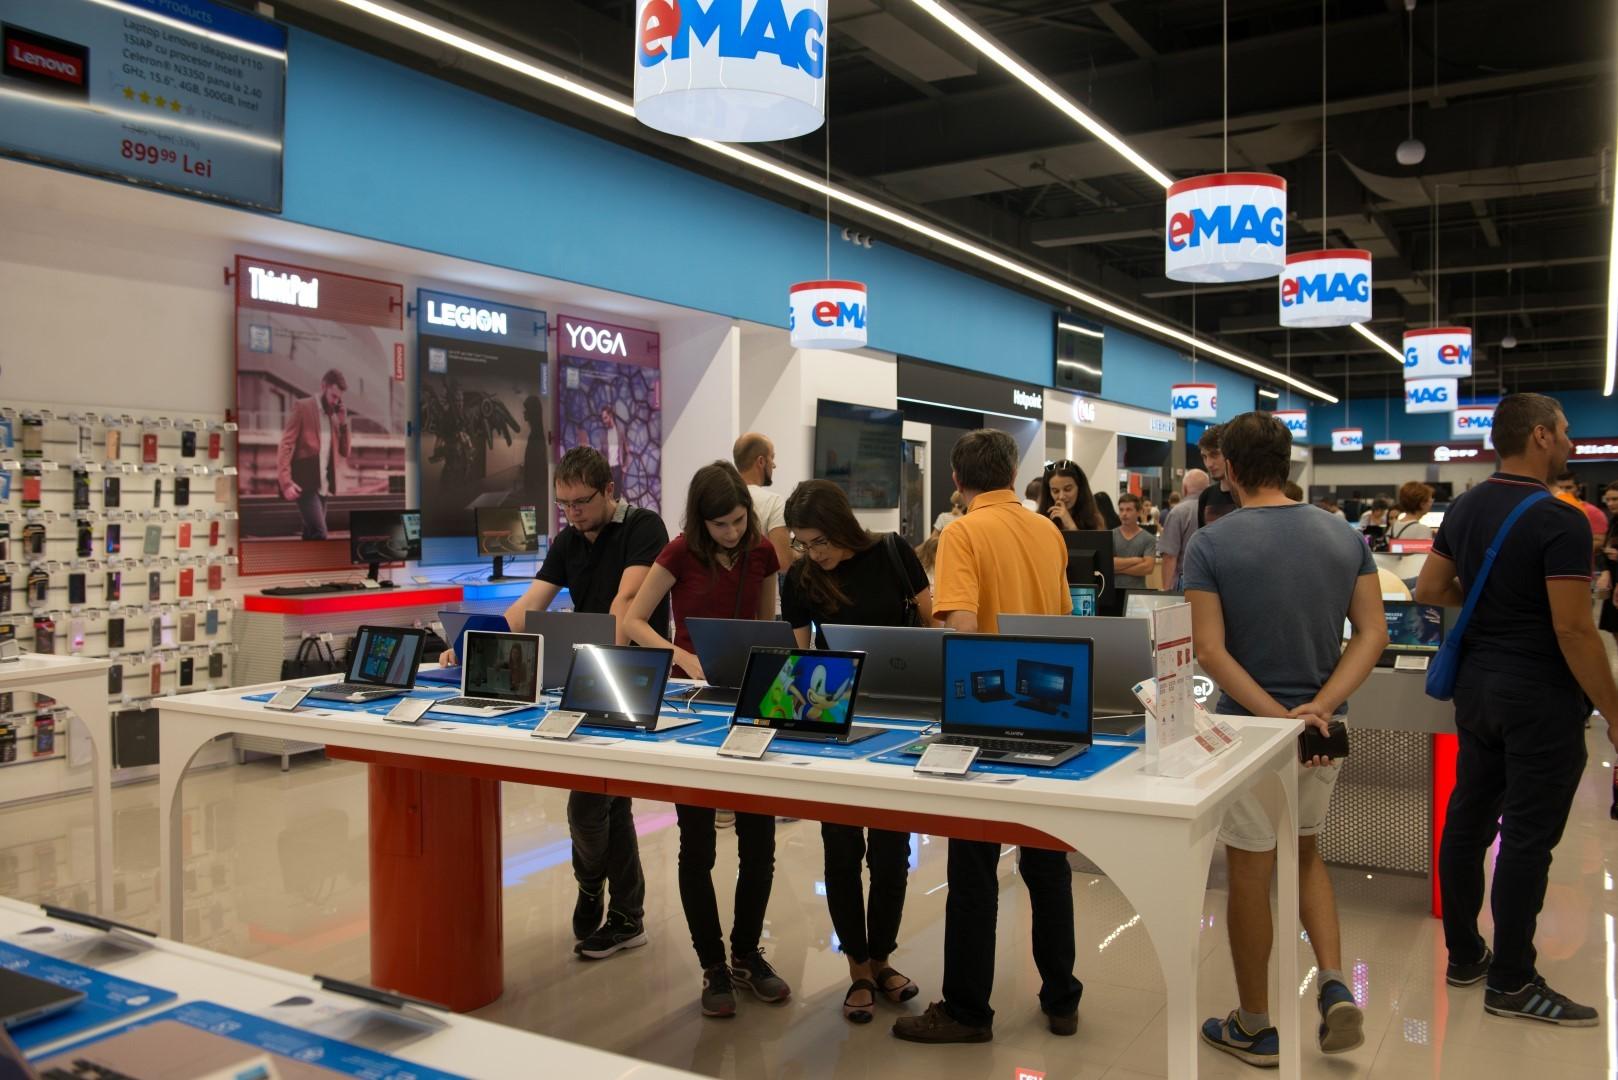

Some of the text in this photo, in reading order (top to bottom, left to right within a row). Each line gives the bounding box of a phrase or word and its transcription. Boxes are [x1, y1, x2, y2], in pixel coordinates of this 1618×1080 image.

[123, 18, 160, 38] Laptop
[162, 32, 198, 50] Lenovo
[639, 0, 824, 79] eMAG
[13, 45, 77, 76] Lenovo
[155, 45, 167, 56] cu
[169, 50, 212, 69] procesor
[174, 63, 205, 80] N3350
[207, 75, 231, 91] pana
[233, 80, 241, 92] la
[243, 85, 262, 98] 2.40
[238, 98, 259, 112] Intel
[183, 154, 212, 178] Lei
[1168, 204, 1284, 252] eMAG
[248, 266, 319, 309] ThinkPad
[1281, 272, 1370, 308] eMAG
[427, 300, 507, 335] LEGION
[565, 322, 627, 357] YOGA
[1406, 387, 1448, 404] MAG
